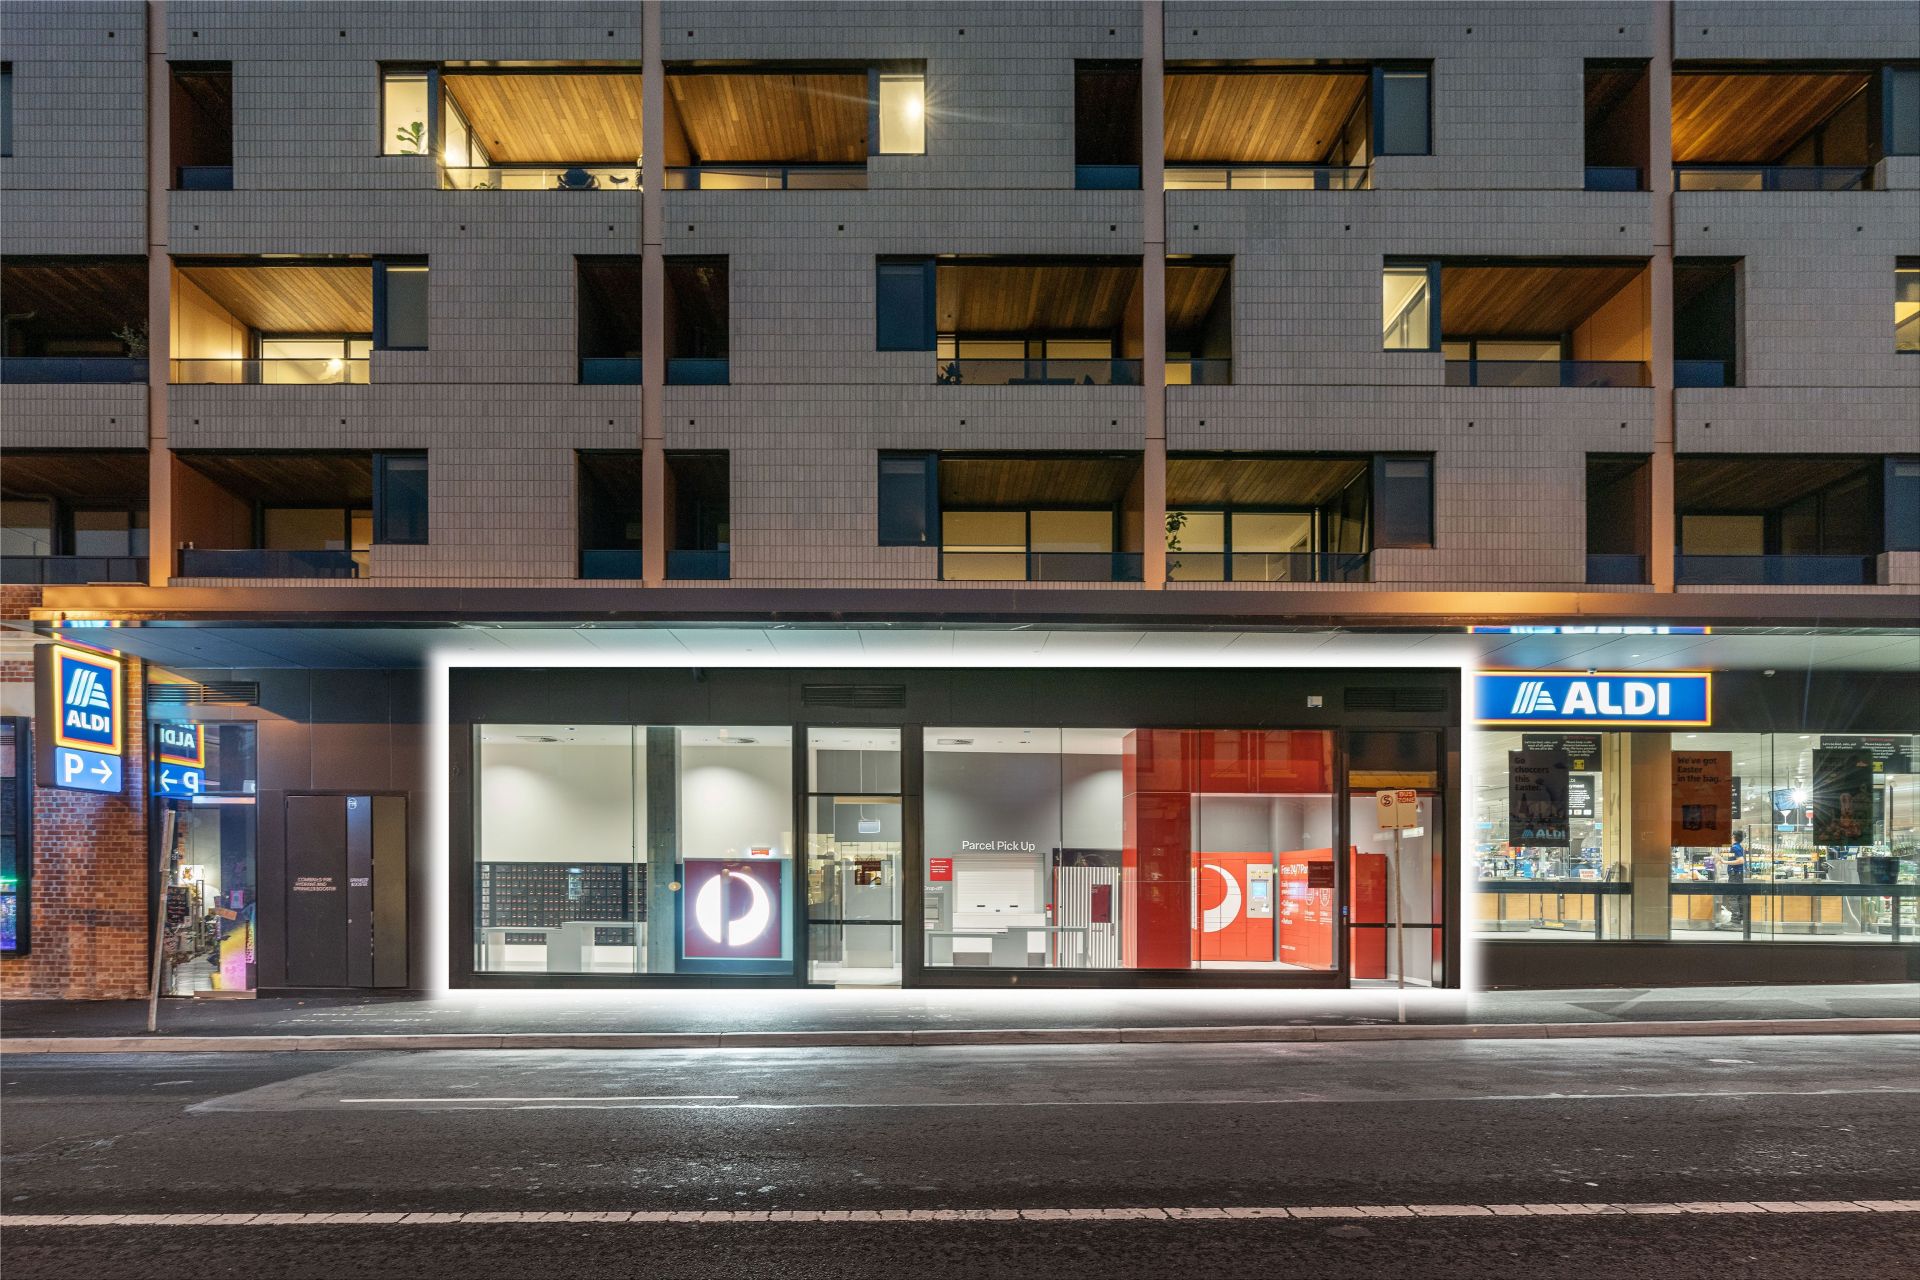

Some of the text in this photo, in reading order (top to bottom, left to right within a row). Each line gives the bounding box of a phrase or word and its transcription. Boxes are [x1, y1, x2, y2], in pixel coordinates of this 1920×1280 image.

[1561, 681, 1670, 715] ALDI
[66, 710, 110, 733] ALDI
[64, 753, 84, 783] P
[1703, 758, 1718, 766] got
[1535, 829, 1566, 839] ALDI
[962, 841, 1036, 852] Parcel Pick Up
